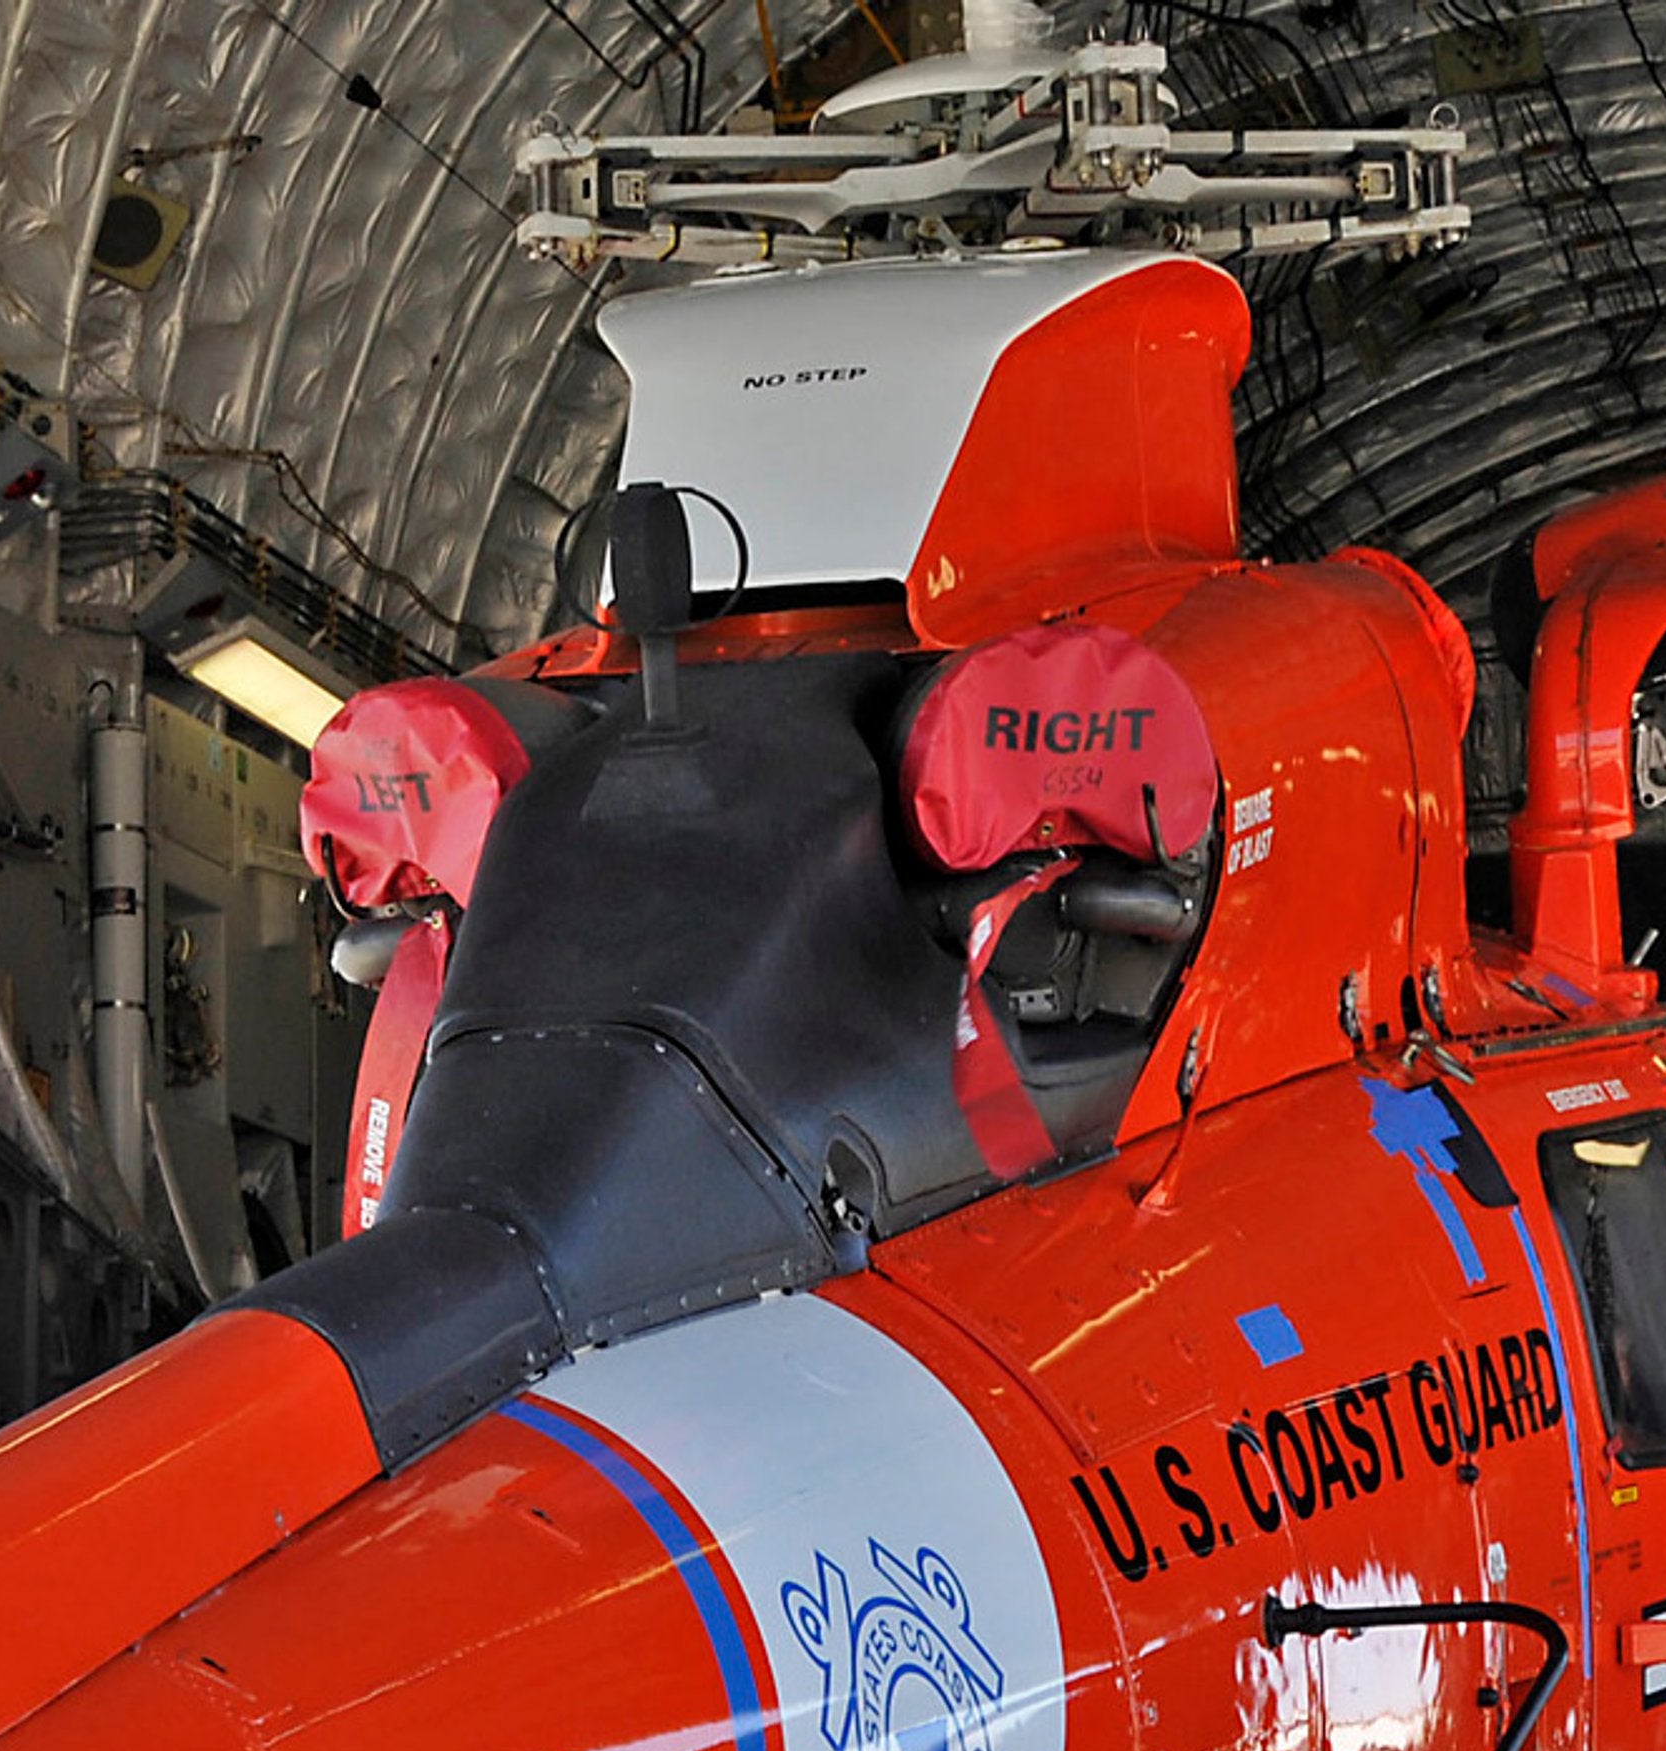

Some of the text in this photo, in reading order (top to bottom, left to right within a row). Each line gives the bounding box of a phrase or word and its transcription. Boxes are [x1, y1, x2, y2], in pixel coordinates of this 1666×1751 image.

[743, 366, 868, 390] NO STEP
[985, 705, 1156, 755] RIGHT
[353, 770, 431, 813] LEFT
[362, 1096, 391, 1188] REMOVE
[1227, 1371, 1405, 1533] COAST
[1410, 1327, 1564, 1467] GUARD
[862, 1618, 898, 1748] STATES
